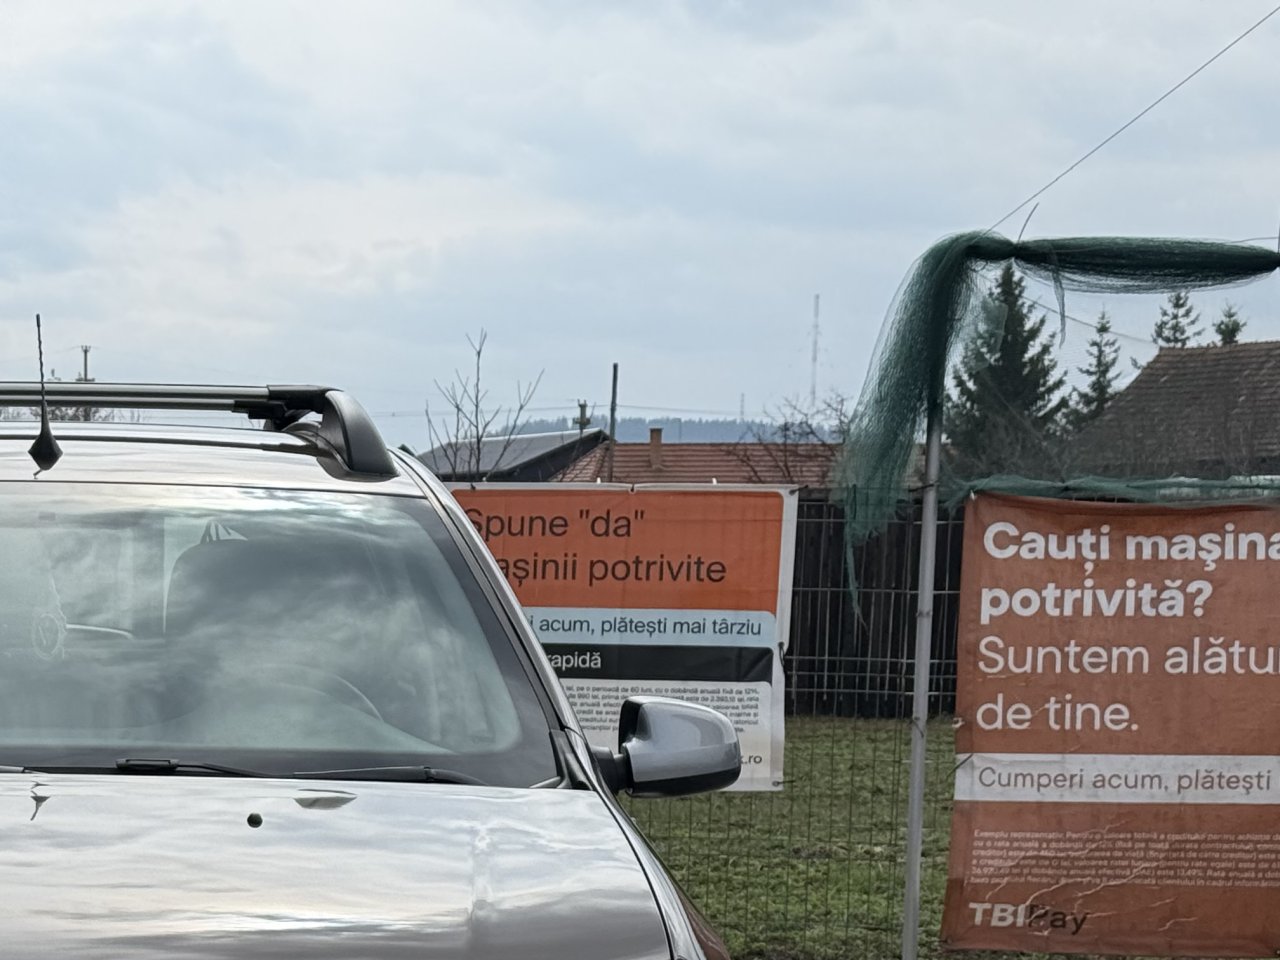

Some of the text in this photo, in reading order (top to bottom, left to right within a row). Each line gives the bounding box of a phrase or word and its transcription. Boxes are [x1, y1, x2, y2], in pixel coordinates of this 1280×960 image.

[464, 508, 645, 541] Spune "da"
[983, 521, 1111, 576] Cauți
[495, 552, 727, 587] așinii potrivite
[980, 578, 1213, 625] potrivită?
[539, 619, 595, 635] acum,
[600, 616, 667, 638] plătești
[673, 618, 706, 635] mai
[712, 619, 762, 636] târziu
[978, 636, 1280, 675] Suntem alătu
[976, 693, 1139, 731] de tine.
[978, 766, 1084, 792] Cumperi
[1092, 772, 1169, 791] acum,
